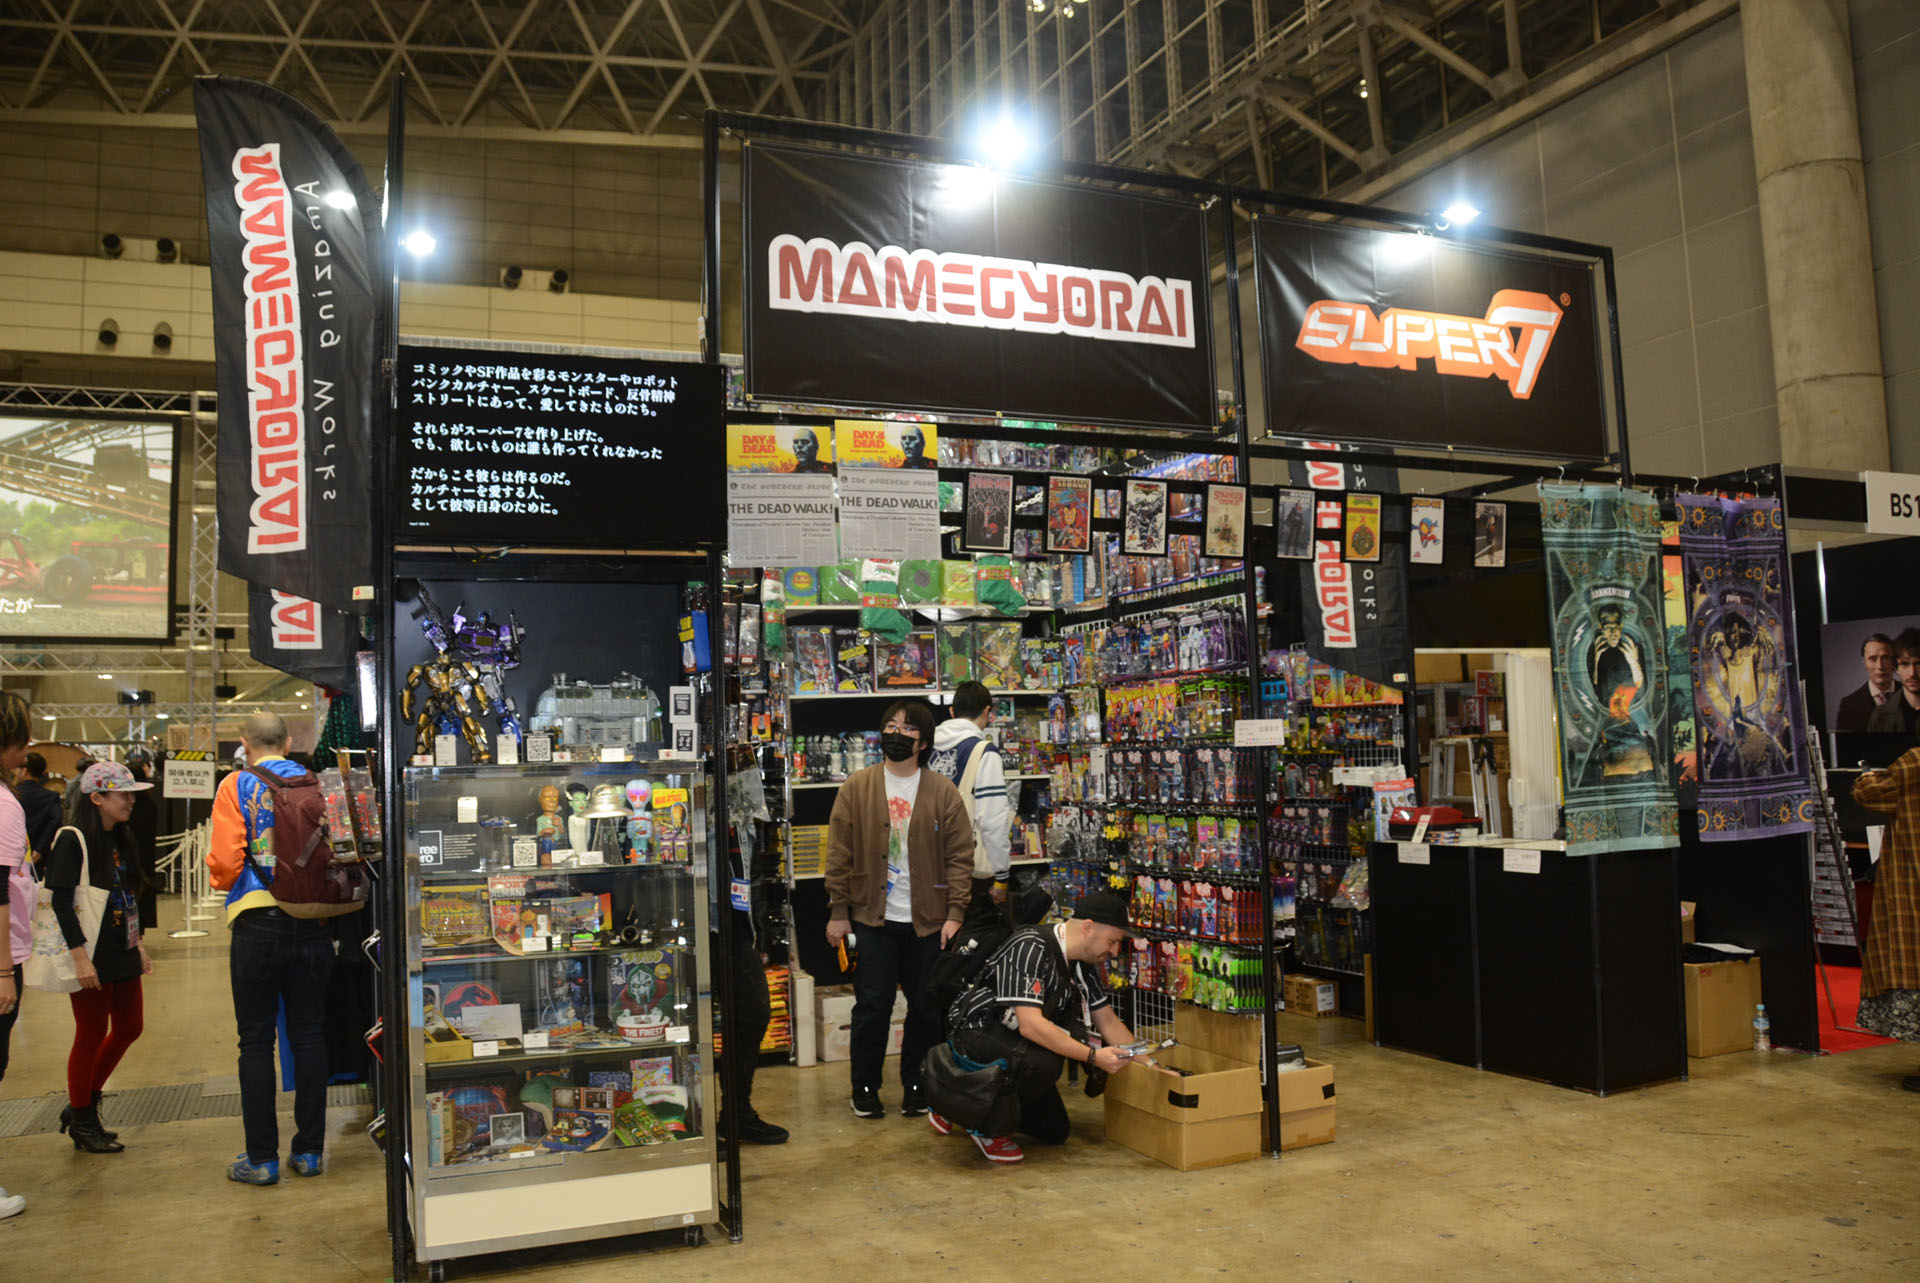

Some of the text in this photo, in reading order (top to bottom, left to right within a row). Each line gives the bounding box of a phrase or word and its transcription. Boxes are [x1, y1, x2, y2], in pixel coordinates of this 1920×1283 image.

[776, 243, 1189, 340] MAMEGYORAI
[412, 362, 679, 388] コミックやSF作品を彩るモンスターやロボット
[411, 392, 658, 417] ストリートにあって、愛してきたものたち。
[411, 421, 605, 443] それらがスーパー7を作り上げた。
[742, 434, 766, 444] DAY
[853, 430, 873, 438] DAY
[411, 437, 663, 460] でも、欲しいものは誰も作ってくれなかった
[743, 444, 777, 454] DEAD
[853, 439, 885, 449] DEAD
[410, 467, 572, 486] だからこそ彼らは作るのだ。
[410, 483, 547, 501] カルチャーを愛する人、
[730, 503, 834, 514] THE DEAD WALK!
[840, 496, 938, 509] THE DEAD WALK!
[624, 1026, 664, 1038] THE FINEST
